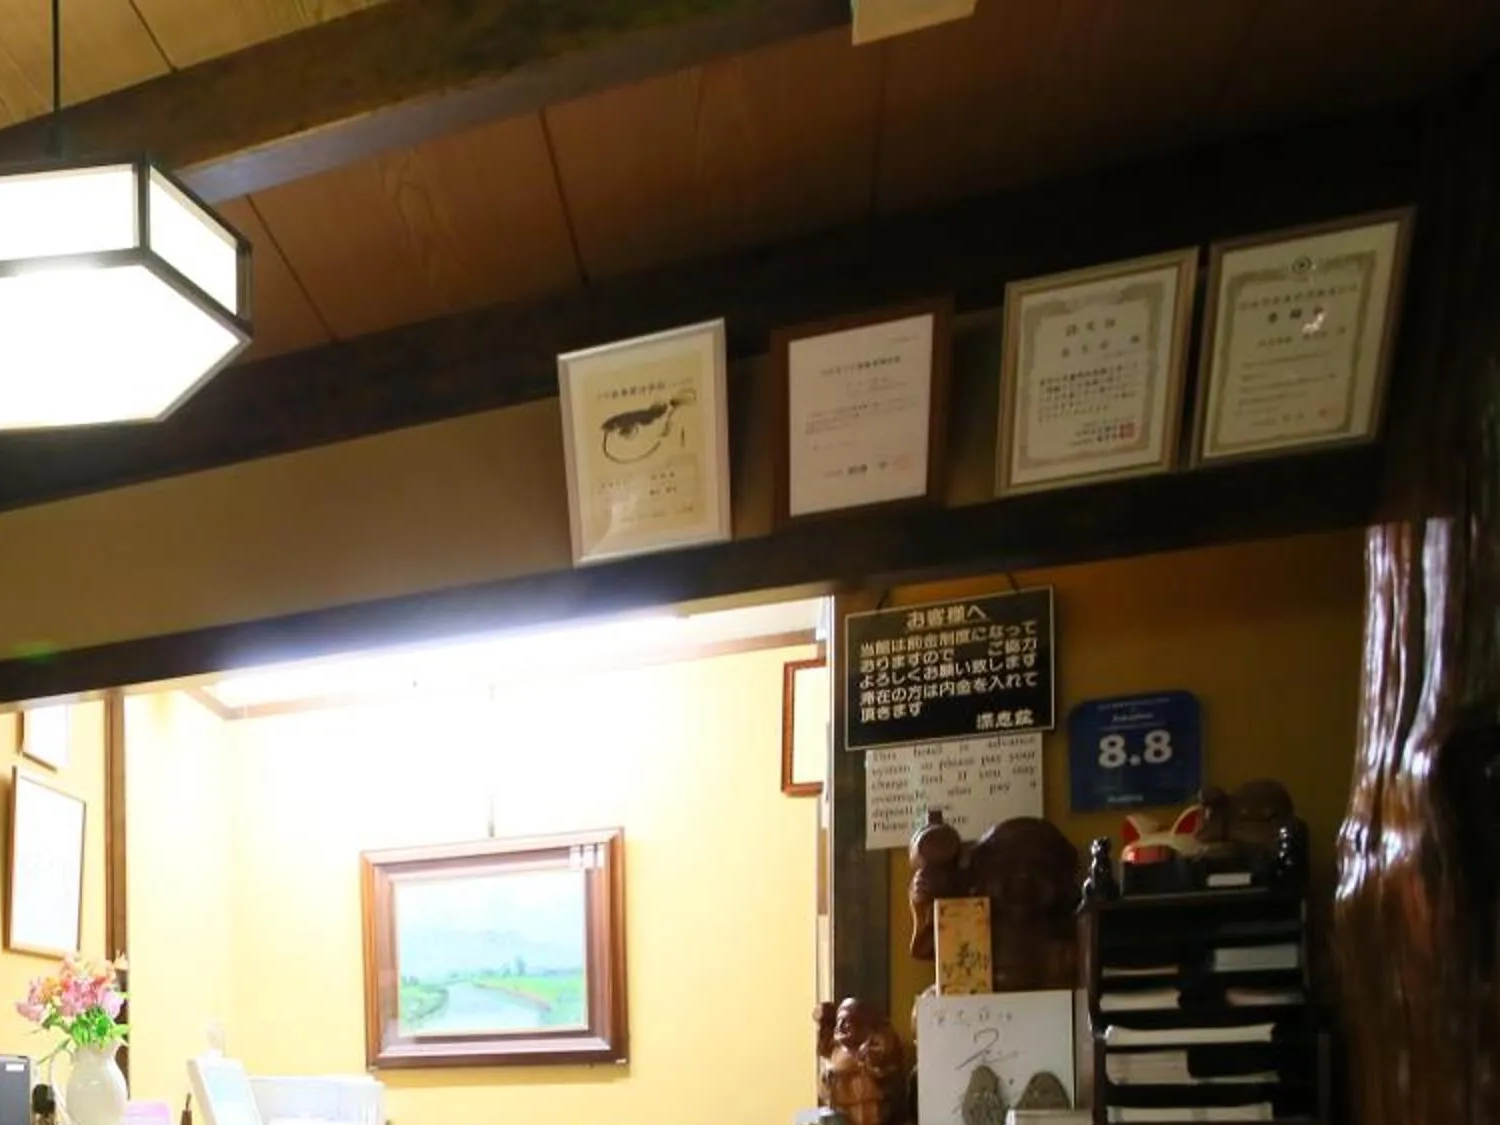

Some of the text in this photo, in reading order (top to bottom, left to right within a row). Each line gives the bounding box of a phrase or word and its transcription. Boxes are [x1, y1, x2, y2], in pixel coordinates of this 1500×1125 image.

[906, 605, 987, 631] お客様へ
[1098, 729, 1173, 769] 8.8
